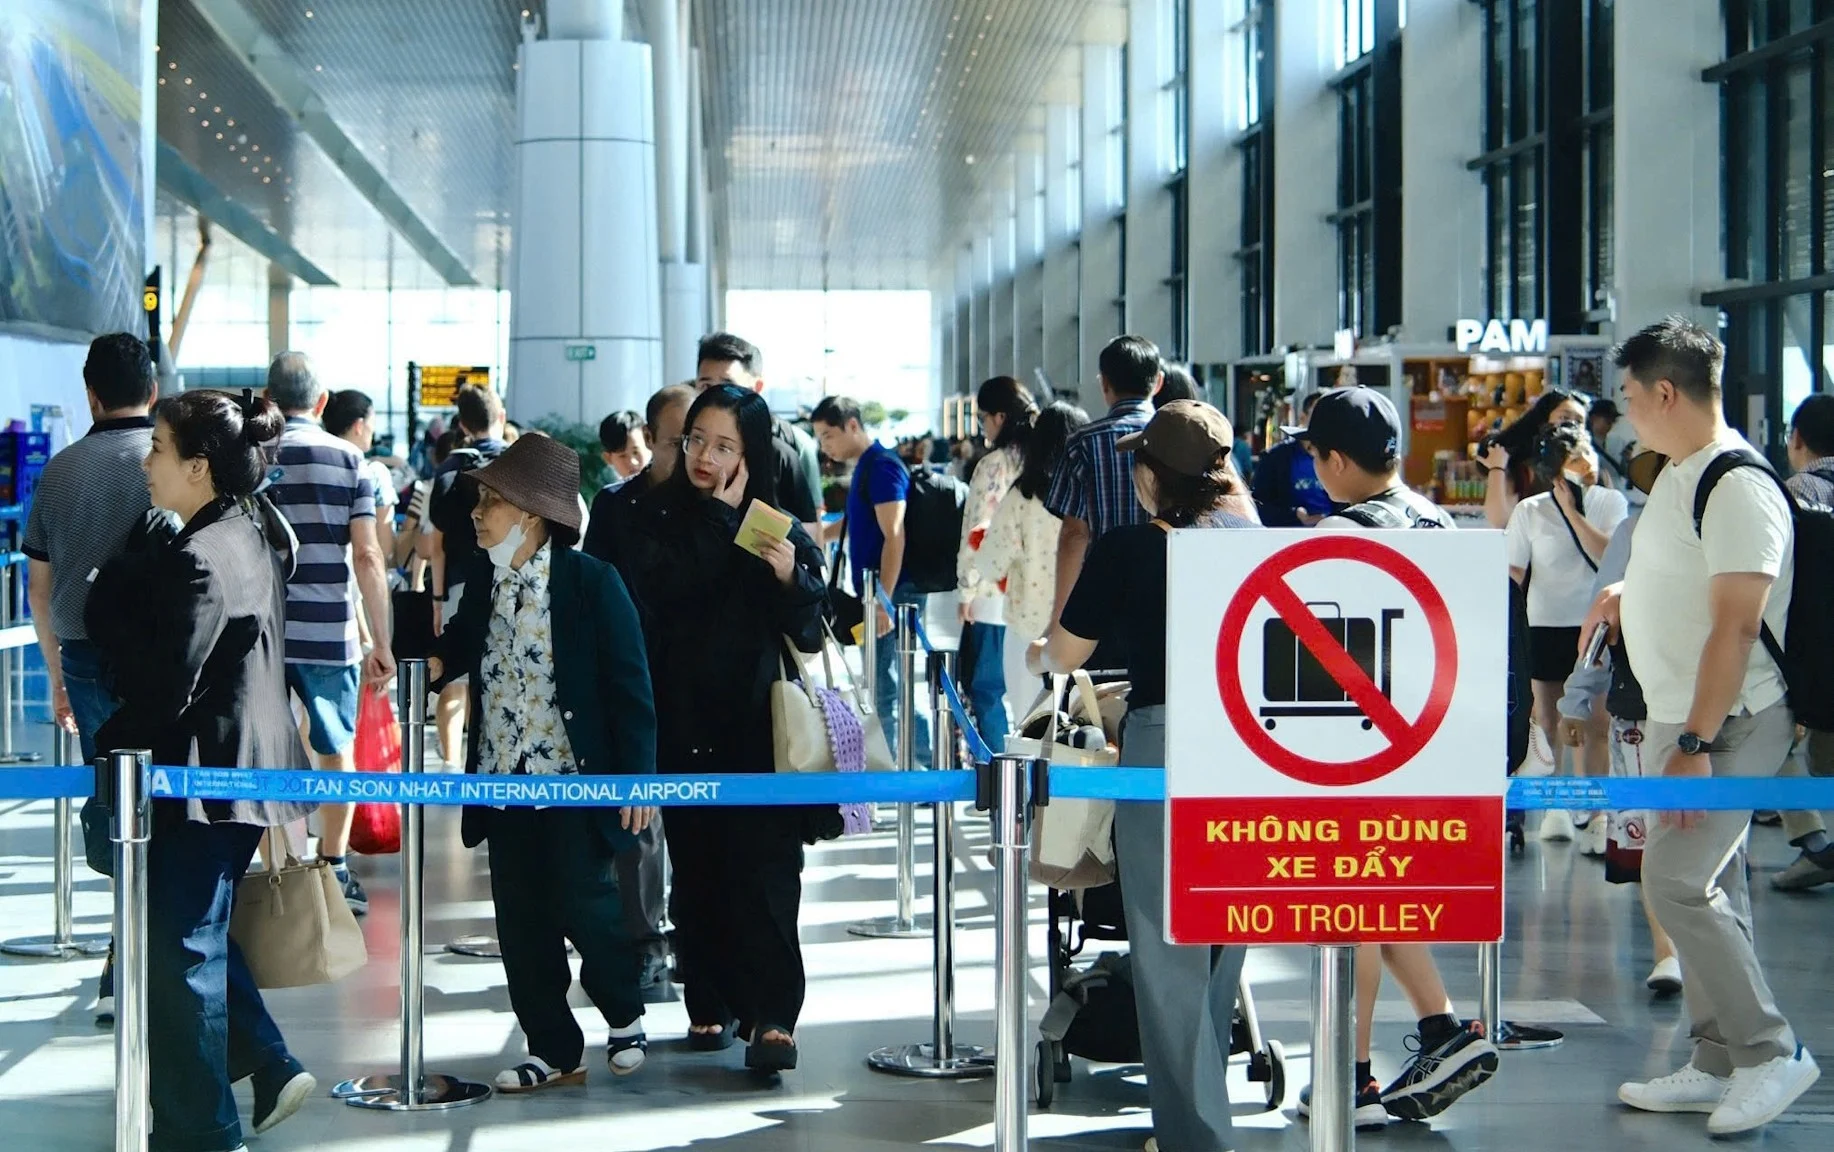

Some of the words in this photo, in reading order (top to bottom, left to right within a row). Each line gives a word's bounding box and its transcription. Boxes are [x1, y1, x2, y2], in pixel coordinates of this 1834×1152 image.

[1456, 318, 1547, 353] PAM
[302, 778, 342, 796] TAN
[349, 779, 394, 797] SON
[399, 781, 455, 798] NHAT
[461, 782, 623, 800] INTERNATIONAL
[629, 781, 721, 800] AIRPORT
[1206, 815, 1340, 842] KHÔNG
[1359, 814, 1467, 841] DÙNG
[1266, 856, 1317, 878] XE
[1333, 845, 1413, 878] ĐẨY
[1227, 905, 1273, 933] NO
[1287, 903, 1444, 932] TROLLEY
